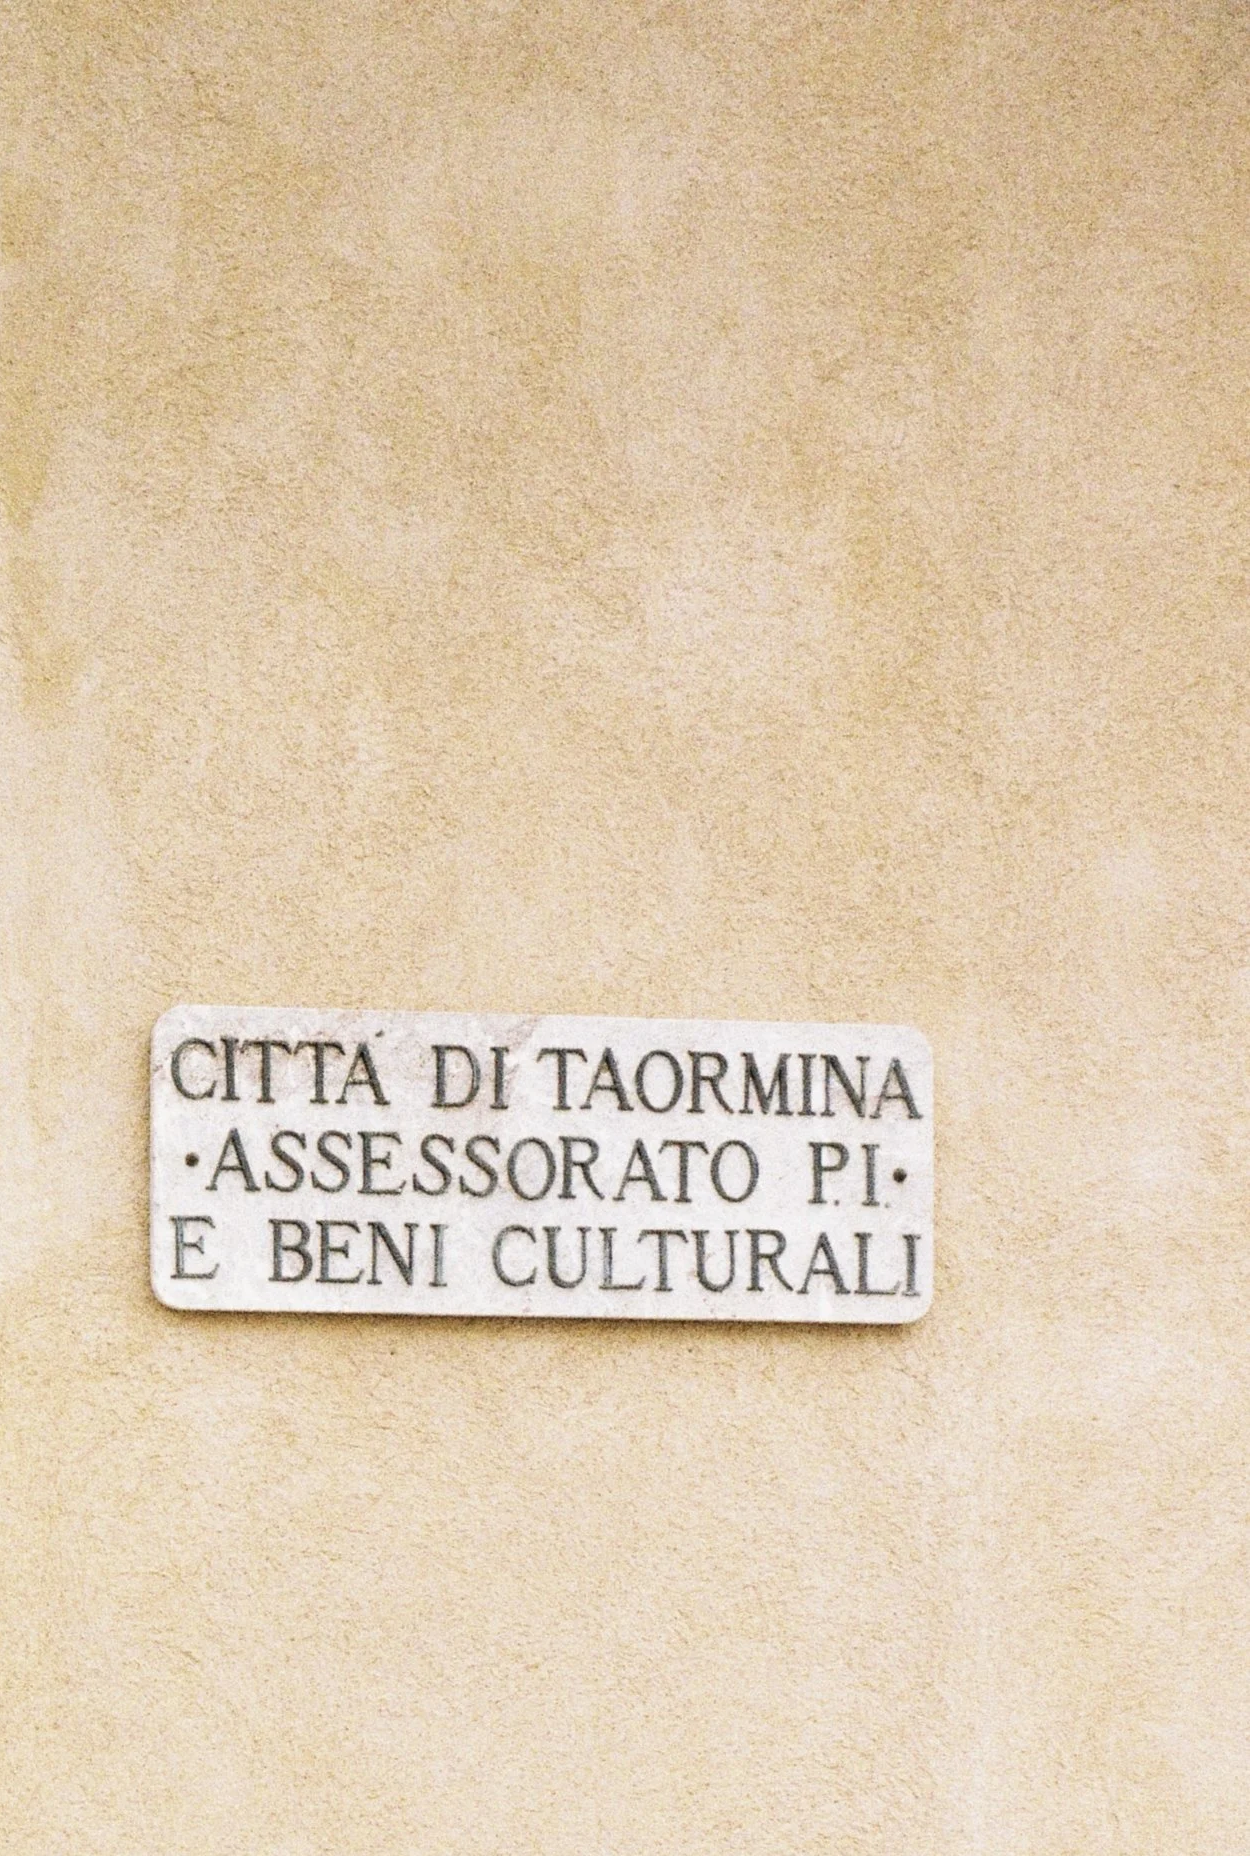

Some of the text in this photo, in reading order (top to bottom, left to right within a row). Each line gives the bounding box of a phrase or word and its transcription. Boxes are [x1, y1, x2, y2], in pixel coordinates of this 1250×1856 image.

[429, 1043, 511, 1112] DI
[535, 1046, 924, 1121] TAORMINA
[204, 1126, 761, 1206] ASSESSORATO
[168, 1214, 923, 1299] E BENI CULTURALI
